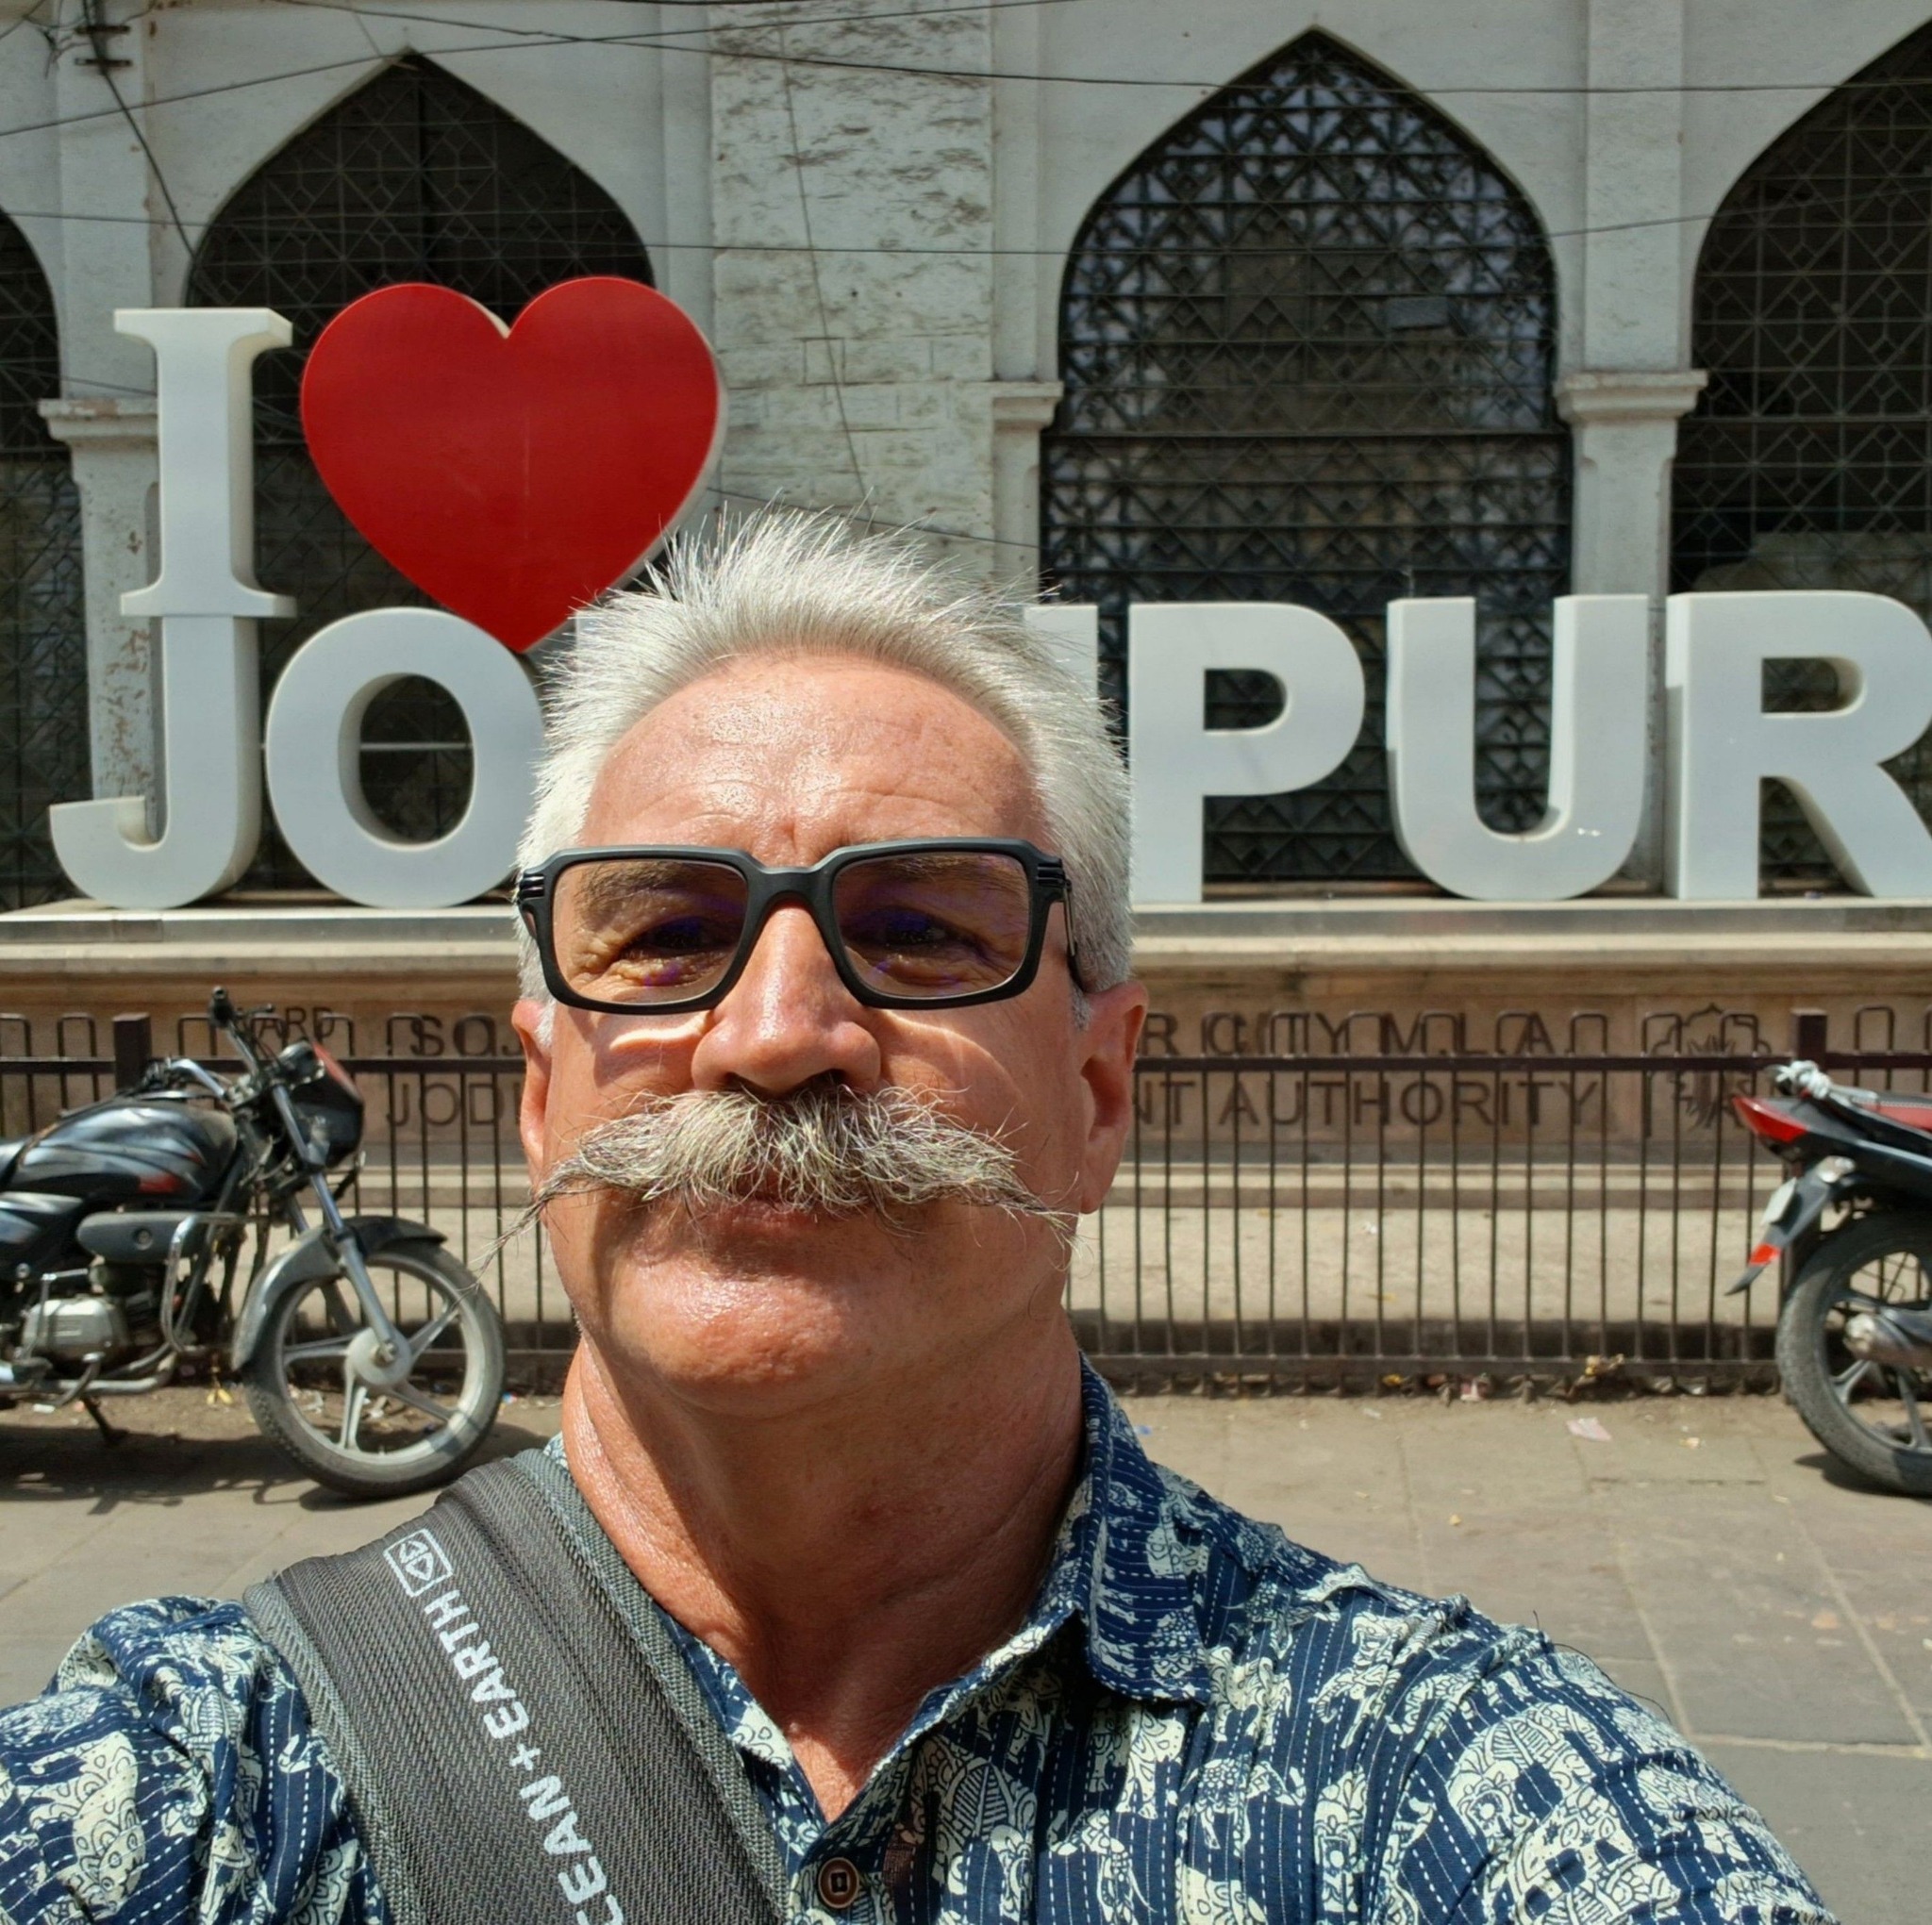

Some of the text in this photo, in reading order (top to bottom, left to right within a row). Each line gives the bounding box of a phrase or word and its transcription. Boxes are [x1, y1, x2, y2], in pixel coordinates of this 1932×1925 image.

[114, 307, 295, 618] I
[50, 590, 1932, 911] JOPUR
[1206, 1011, 1351, 1055] CITY
[1217, 1080, 1600, 1126] AUTHORITY
